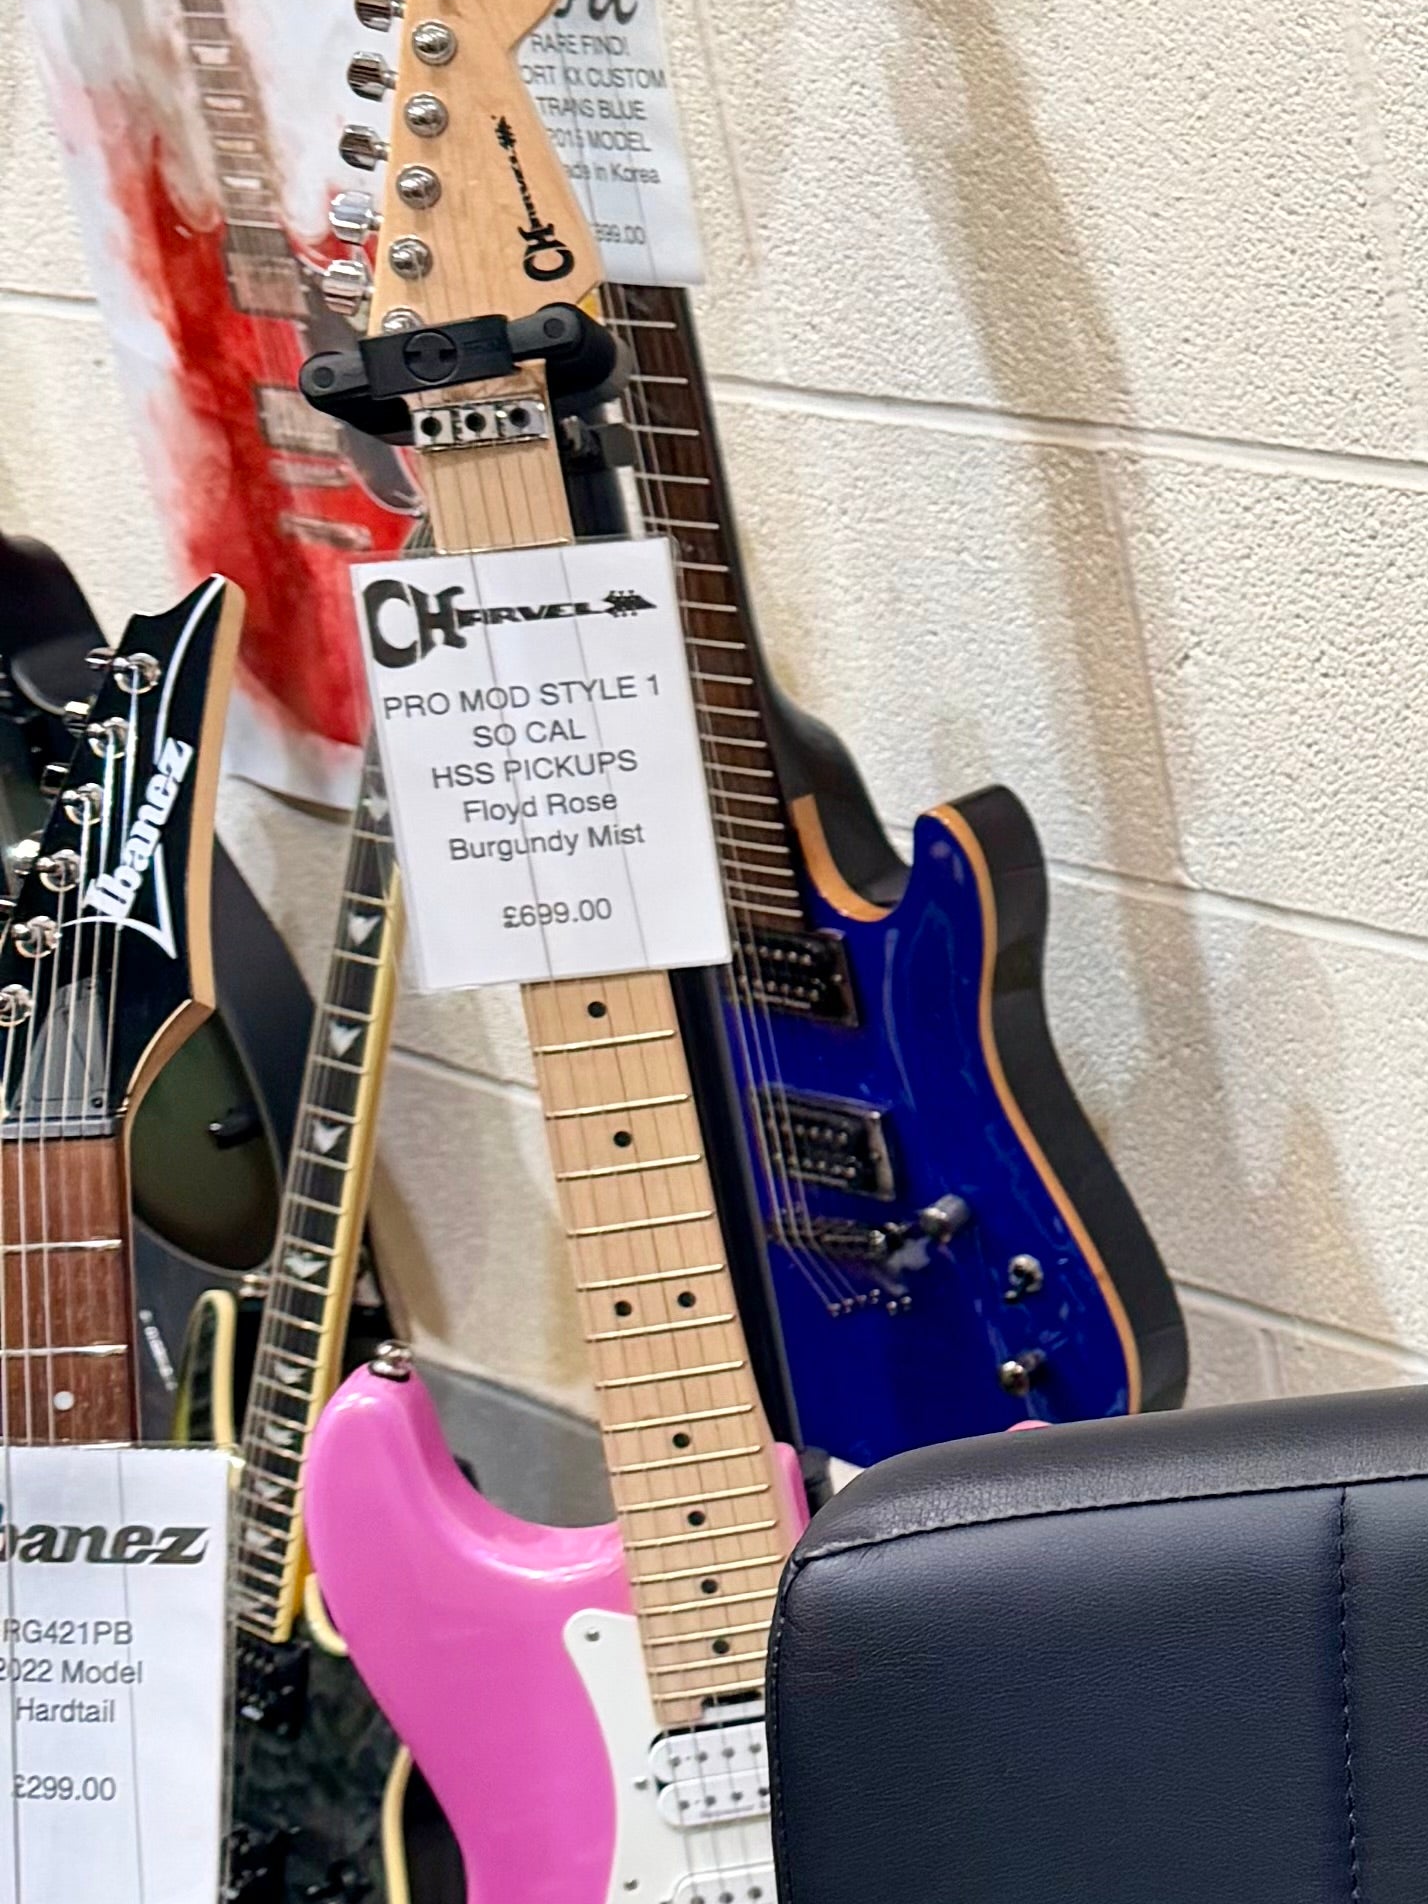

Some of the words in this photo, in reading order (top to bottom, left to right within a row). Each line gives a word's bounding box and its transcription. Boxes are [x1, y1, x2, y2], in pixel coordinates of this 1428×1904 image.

[531, 33, 578, 54] RARE
[520, 65, 555, 85] ORT
[587, 67, 667, 89] CUSTOM
[536, 96, 594, 118] TRANS
[598, 99, 647, 121] BLUE
[587, 130, 652, 153] MODEL
[563, 163, 590, 181] ade
[593, 162, 608, 181] in
[610, 163, 661, 184] Korea
[383, 693, 450, 720] PRO
[460, 685, 529, 713] MOD
[540, 677, 636, 705] STYLE
[647, 675, 660, 696] 1
[473, 724, 516, 747] SO
[526, 719, 586, 743] CAL
[432, 763, 495, 789] HSS
[505, 749, 638, 783] PICKUPS
[463, 796, 537, 825] Floyd
[548, 793, 618, 817] Rose
[83, 737, 194, 918] Ibanez
[449, 831, 578, 862] Burgundy
[589, 823, 646, 849] Mist
[502, 897, 612, 929] £699.00
[0, 1504, 210, 1564] anez
[3, 1619, 133, 1645] RG421PB
[62, 1660, 143, 1685] Model
[16, 1698, 115, 1724] Hardtail
[14, 1775, 117, 1802] £299.00
